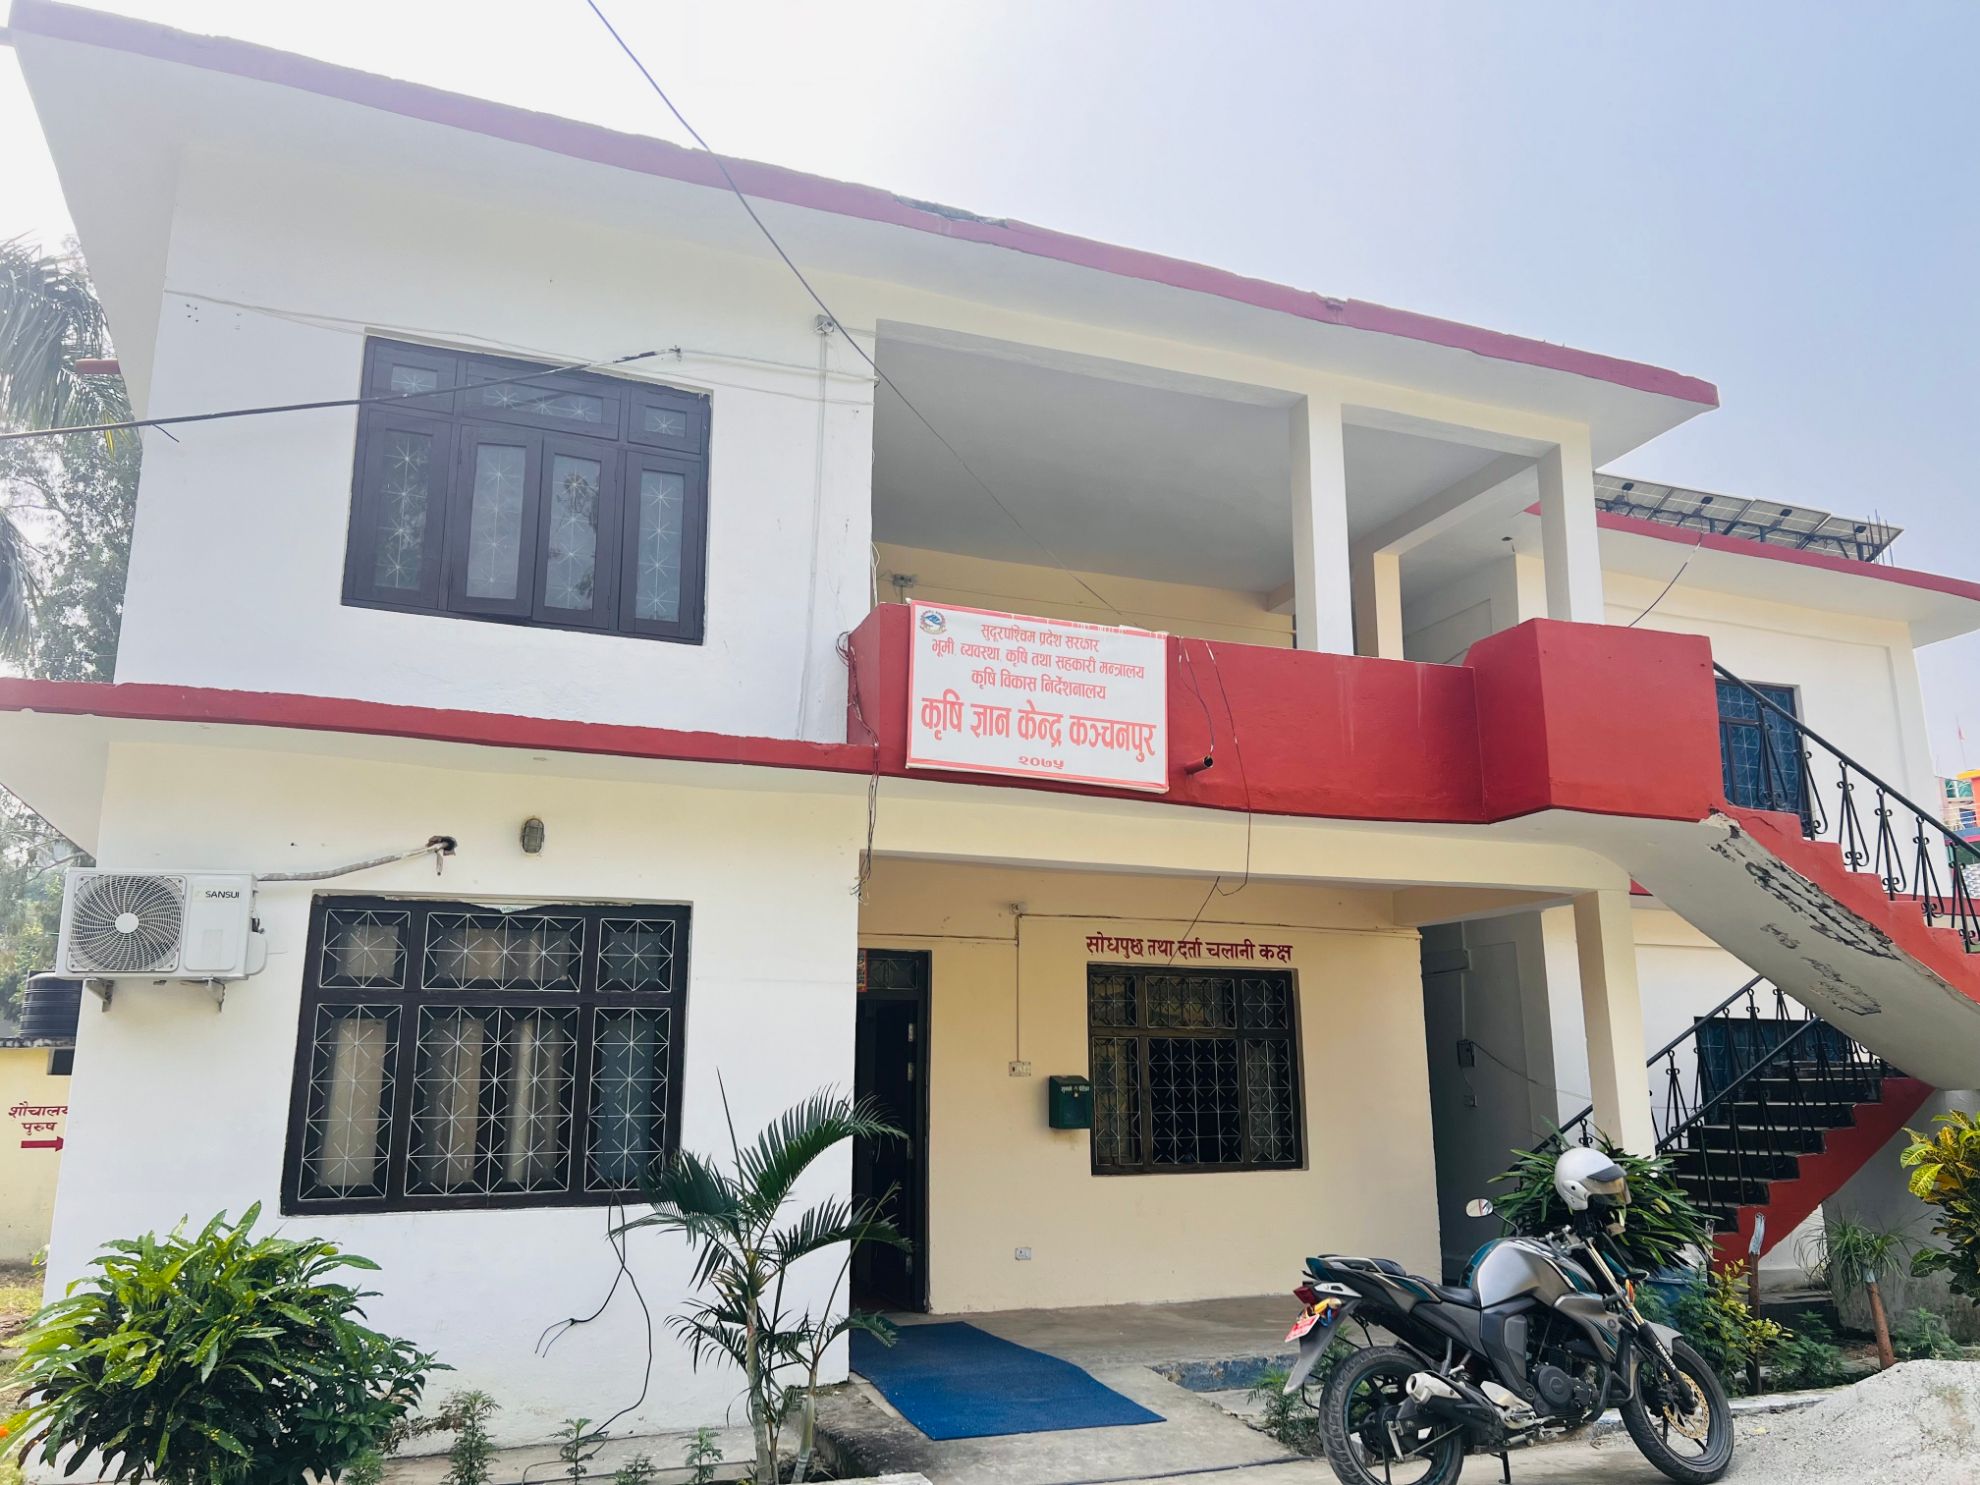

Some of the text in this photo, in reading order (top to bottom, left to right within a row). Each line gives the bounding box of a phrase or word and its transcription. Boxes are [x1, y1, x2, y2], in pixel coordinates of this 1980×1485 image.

[1039, 629, 1062, 647] प्रदेश
[1065, 636, 1100, 652] सरकार
[1006, 646, 1028, 667] कृषि
[1031, 652, 1052, 667] तथा
[1055, 656, 1096, 674] सहकारी
[1099, 661, 1145, 679] मन्त्रालय
[971, 666, 996, 689] कृषि
[1000, 668, 1037, 692] विकास
[921, 688, 1157, 763] कृषि ज्ञान केन्द्र कञ्चनपुर
[1018, 755, 1065, 770] २०७५
[205, 890, 240, 899] SANSUI
[1146, 938, 1175, 957] तथा
[1177, 937, 1203, 960] दर्ता
[1205, 938, 1256, 960] चलानी
[1258, 943, 1294, 964] कक्ष
